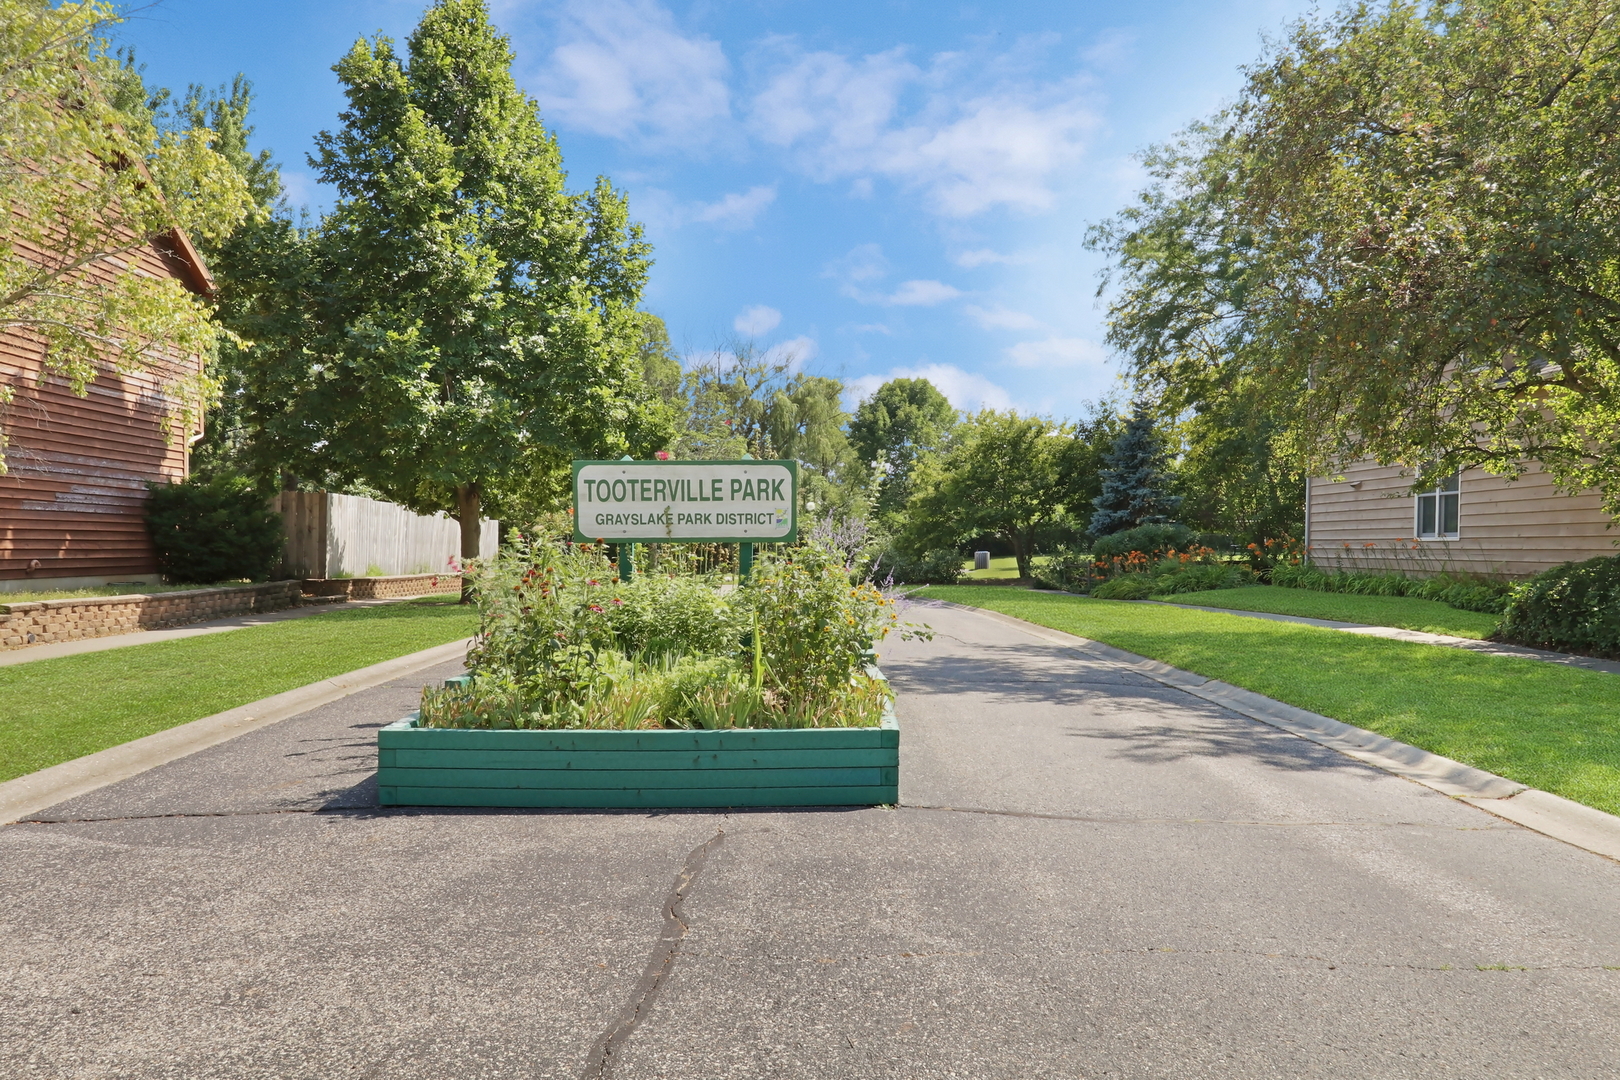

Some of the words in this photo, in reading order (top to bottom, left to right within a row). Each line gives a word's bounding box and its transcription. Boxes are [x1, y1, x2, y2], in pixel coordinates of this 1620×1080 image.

[583, 478, 723, 503] TOOTERVILLE
[730, 478, 786, 501] PARK
[595, 513, 674, 526] GRAYSLAKE
[677, 513, 712, 525] PARK
[716, 512, 774, 525] DISTRICT
